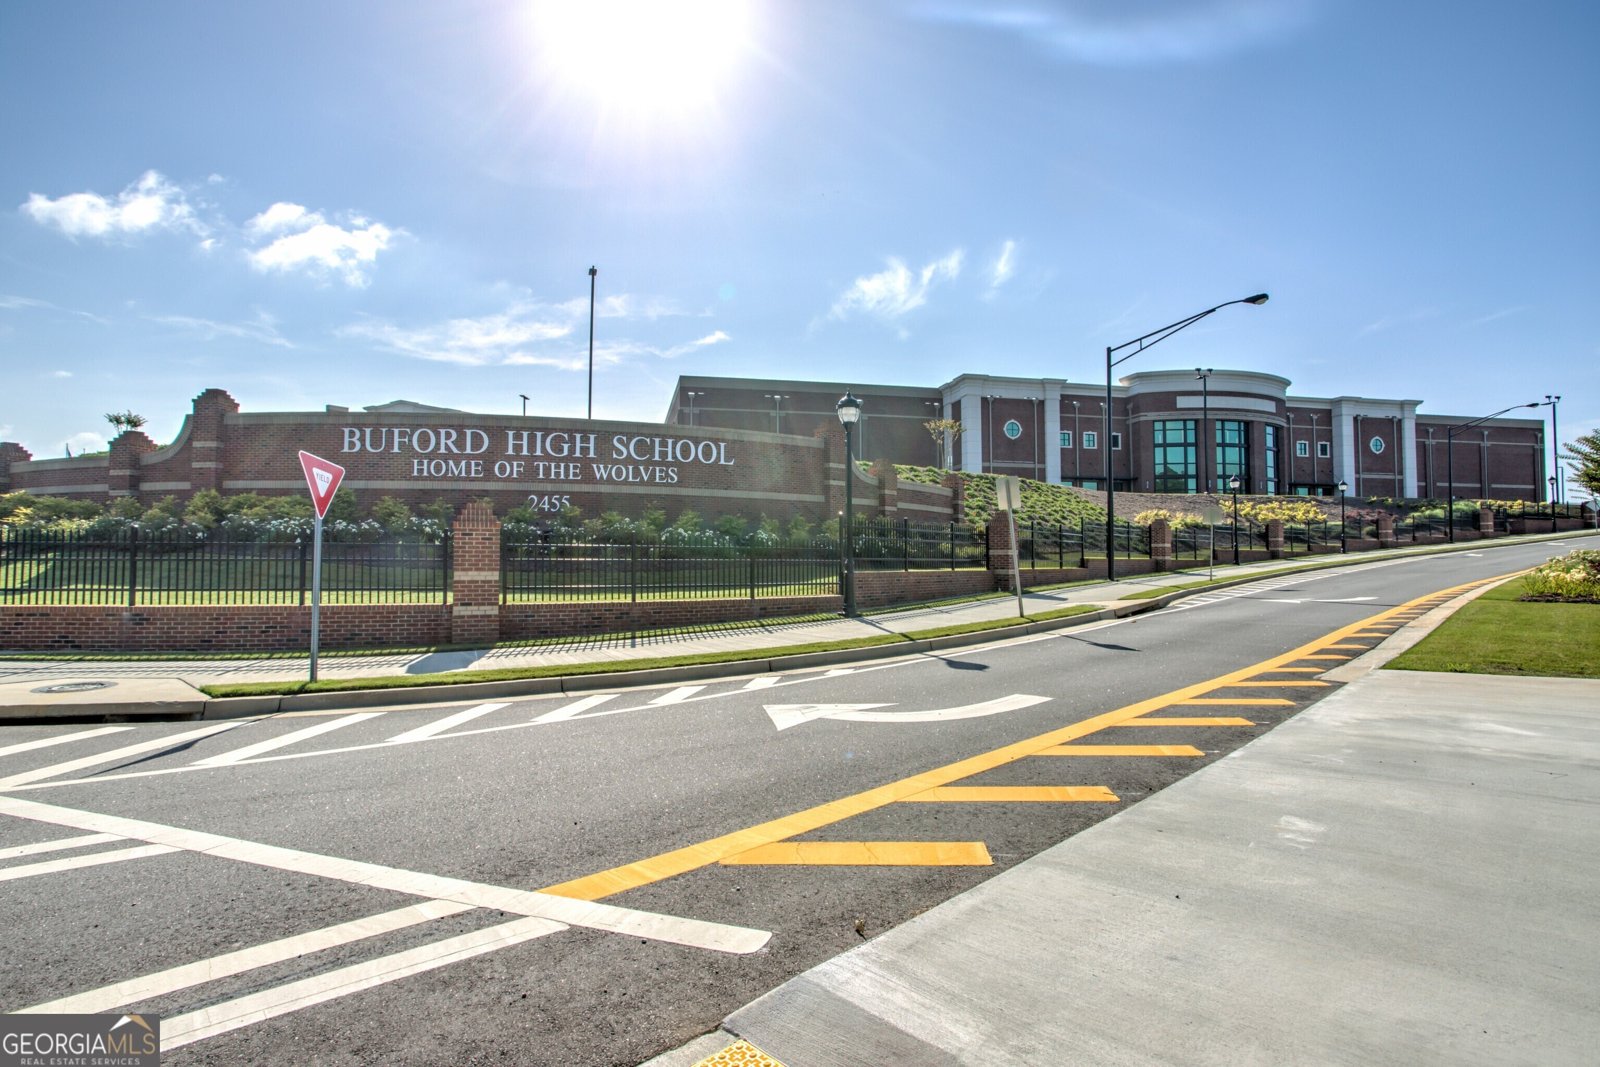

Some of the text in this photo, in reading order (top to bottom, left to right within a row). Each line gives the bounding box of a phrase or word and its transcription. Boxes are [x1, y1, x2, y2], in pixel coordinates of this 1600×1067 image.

[341, 427, 735, 466] BUFORD HIGH SCHOOL
[315, 472, 330, 484] YIELD
[412, 459, 678, 483] HOME OF THE WOLVES
[527, 495, 570, 512] 2455
